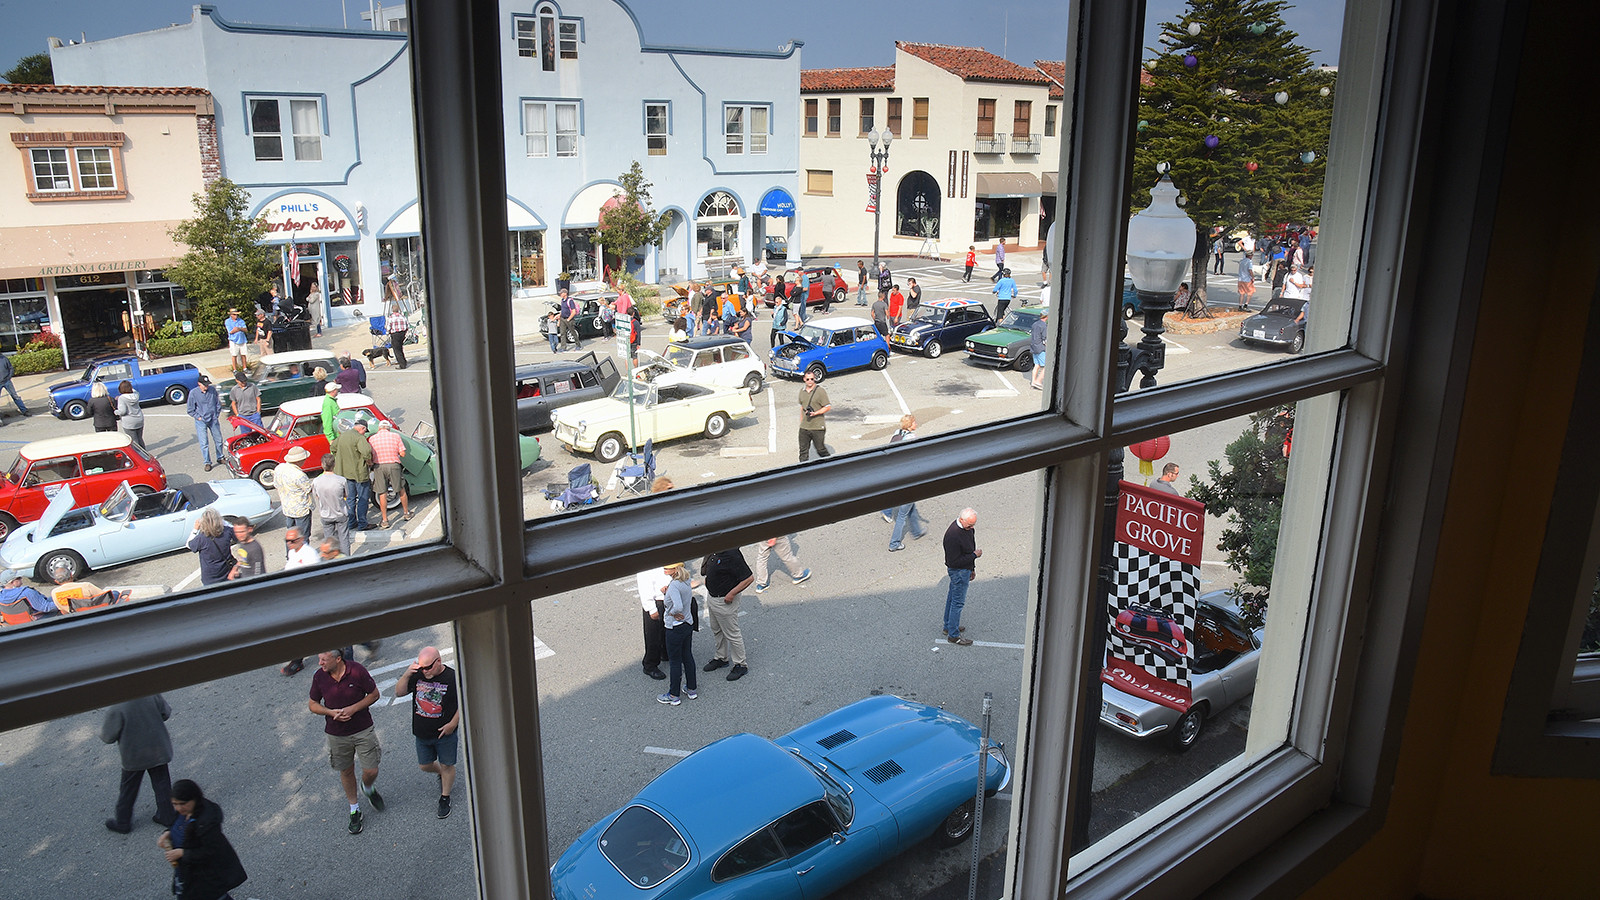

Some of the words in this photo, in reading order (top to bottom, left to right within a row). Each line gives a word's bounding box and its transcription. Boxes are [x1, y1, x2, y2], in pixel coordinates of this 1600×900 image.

[280, 203, 319, 213] PHILL'S
[311, 216, 346, 233] Shop
[38, 262, 95, 275] ARTISANA
[98, 260, 148, 272] GALLERY
[80, 275, 100, 284] 612
[1124, 493, 1199, 533] PACIFIC
[1126, 520, 1192, 556] GROVE
